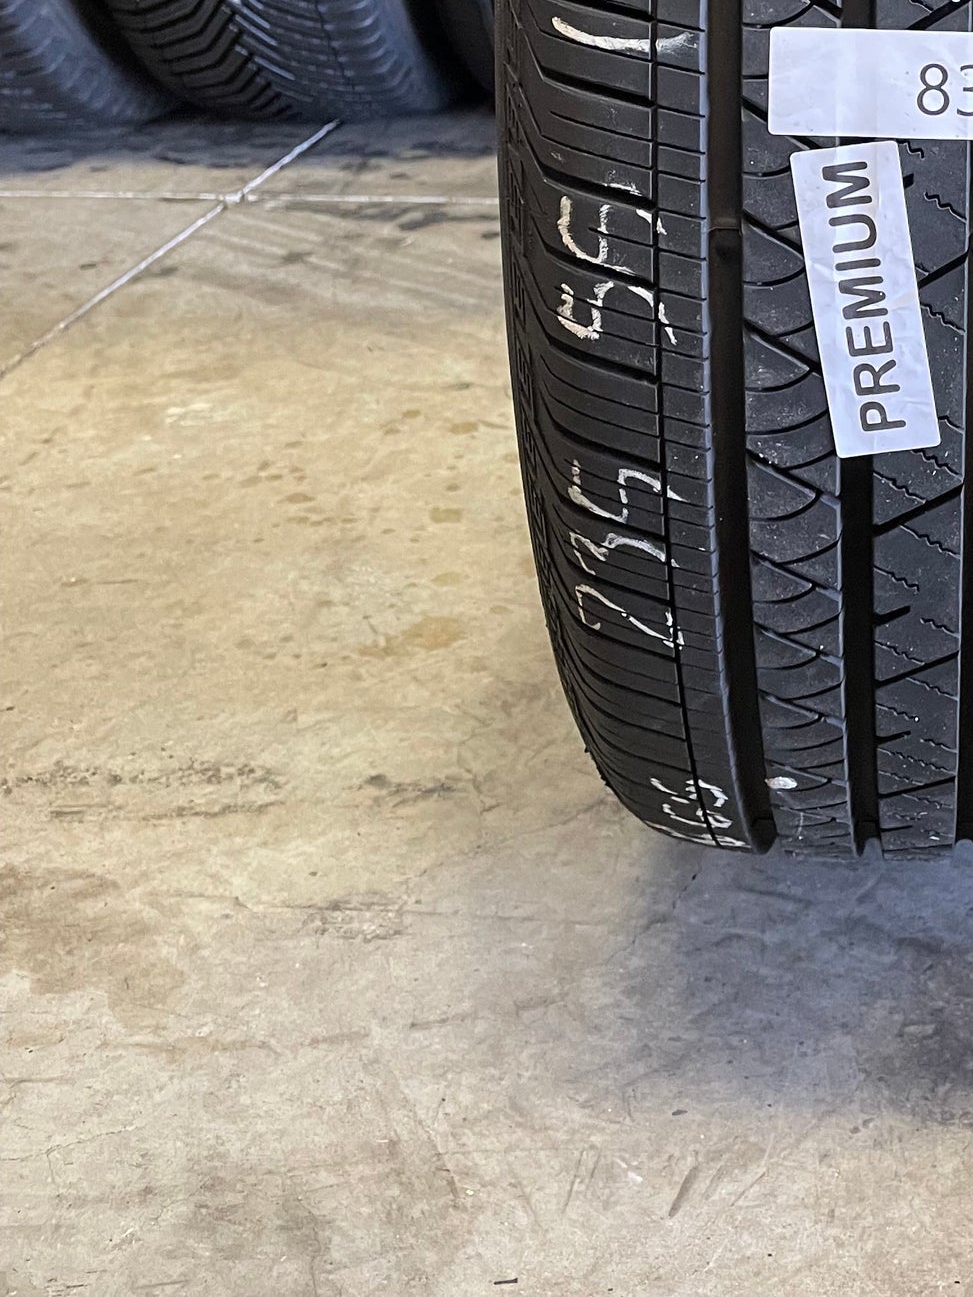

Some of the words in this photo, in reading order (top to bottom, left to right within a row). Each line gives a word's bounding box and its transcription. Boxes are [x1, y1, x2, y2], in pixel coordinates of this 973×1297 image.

[557, 182, 680, 347] 55
[822, 160, 907, 432] PREMIUM
[567, 459, 686, 652] 235
